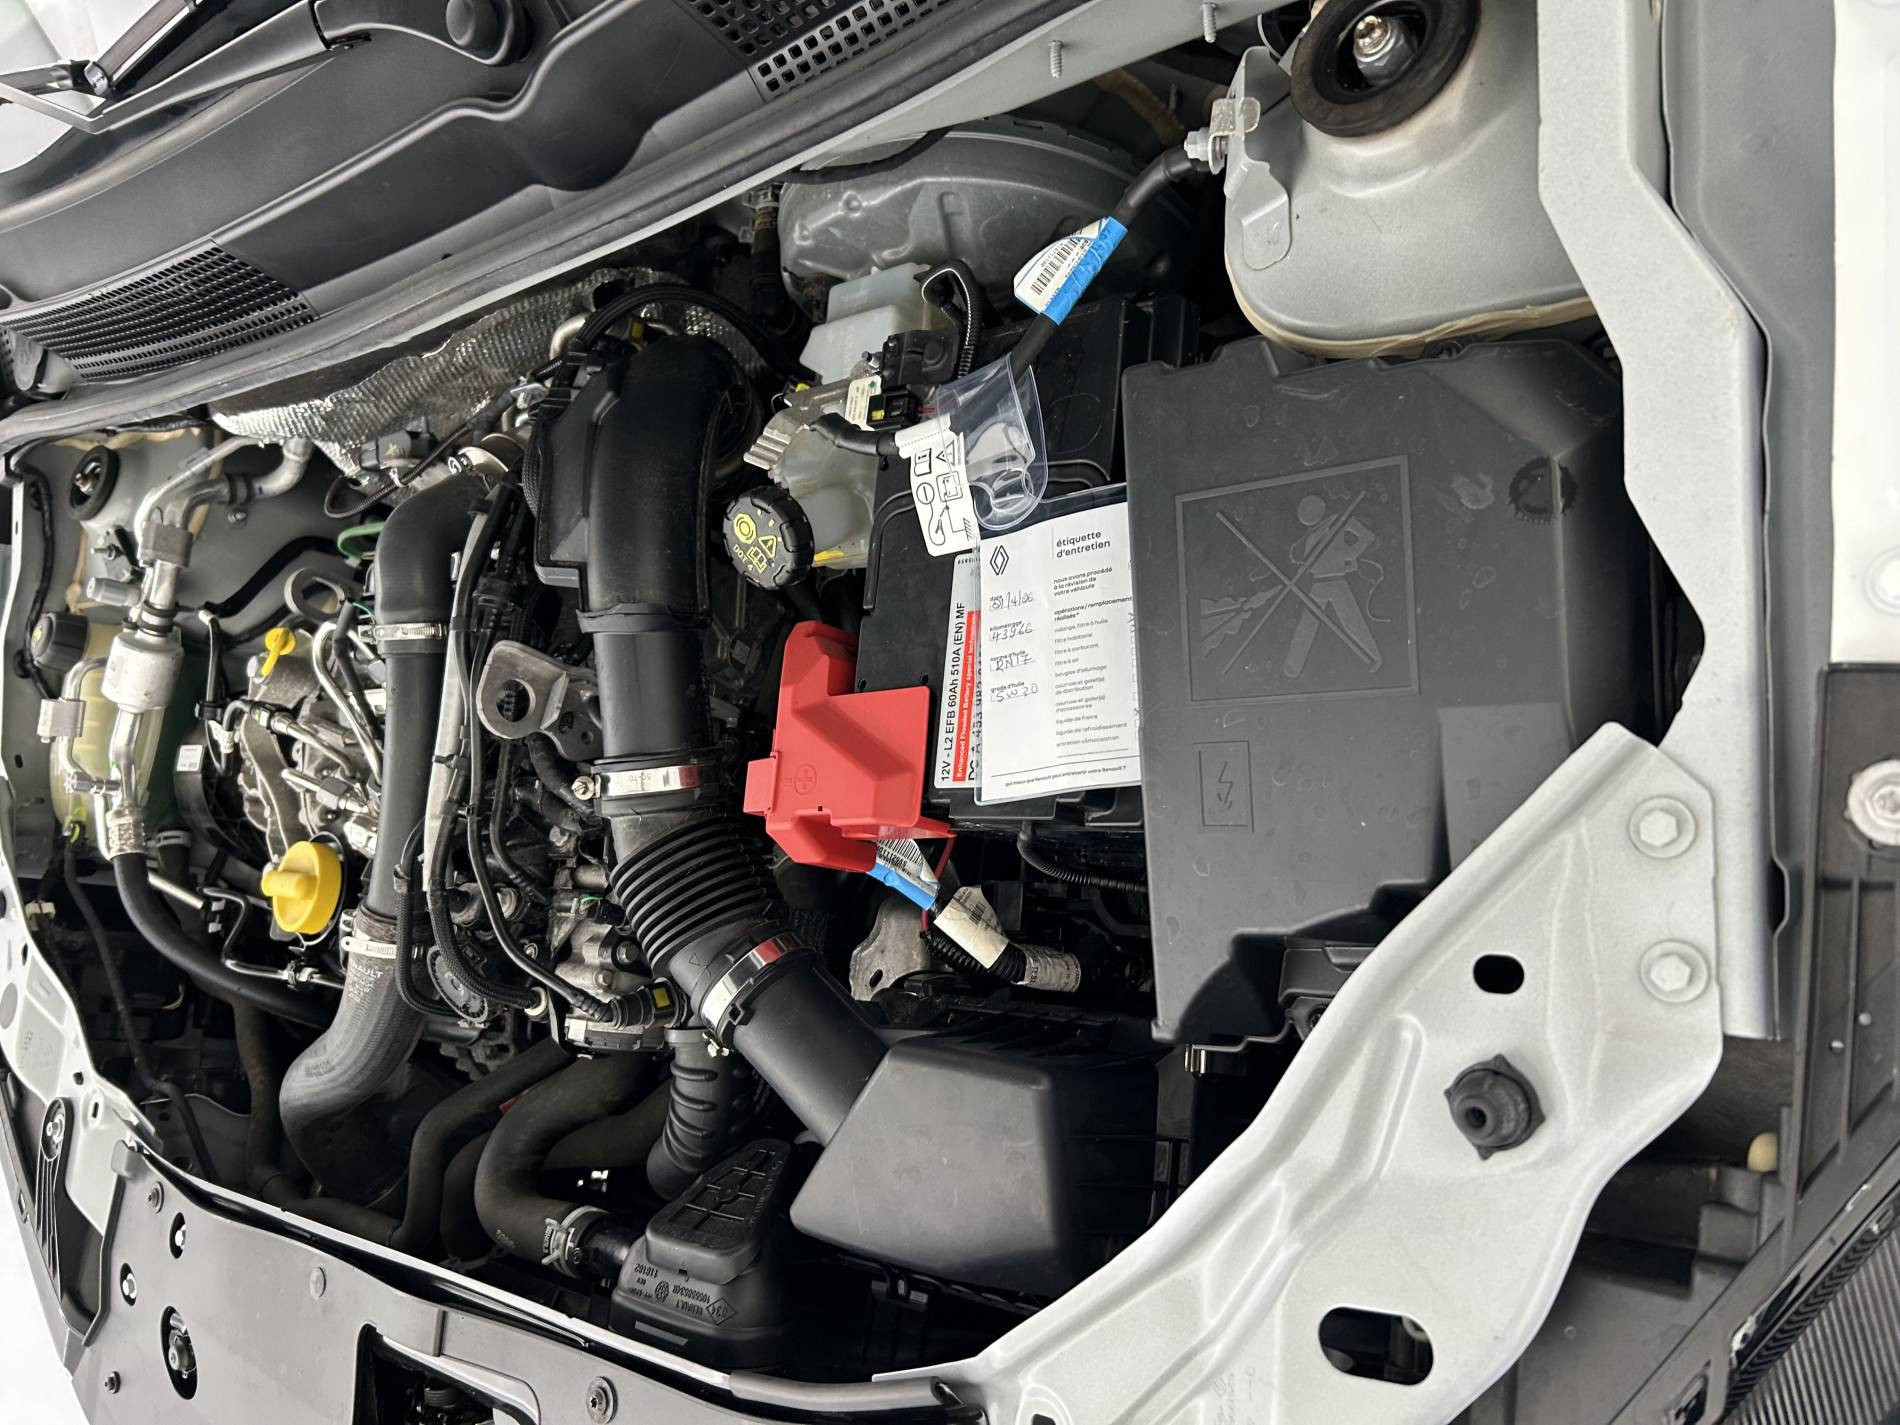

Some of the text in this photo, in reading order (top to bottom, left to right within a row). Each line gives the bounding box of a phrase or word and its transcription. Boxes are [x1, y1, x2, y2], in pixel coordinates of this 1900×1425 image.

[1056, 531, 1102, 547] étiquette
[733, 544, 749, 562] DOT
[1056, 540, 1111, 558] d'entretien
[1053, 566, 1113, 584] nous avons procédé
[1065, 578, 1088, 588] révision
[1054, 583, 1095, 597] votre véhicule
[955, 602, 965, 619] MF
[953, 621, 965, 646] (EN)
[951, 648, 961, 676] 510A
[966, 655, 974, 681] special
[948, 679, 958, 707] 60Ah
[963, 681, 972, 709] Battery
[990, 685, 1007, 693] grade
[945, 711, 955, 734] EFB
[961, 710, 969, 739] Flooded
[944, 737, 953, 750] L2
[957, 740, 966, 778] Enhanced
[941, 761, 951, 781] 12V
